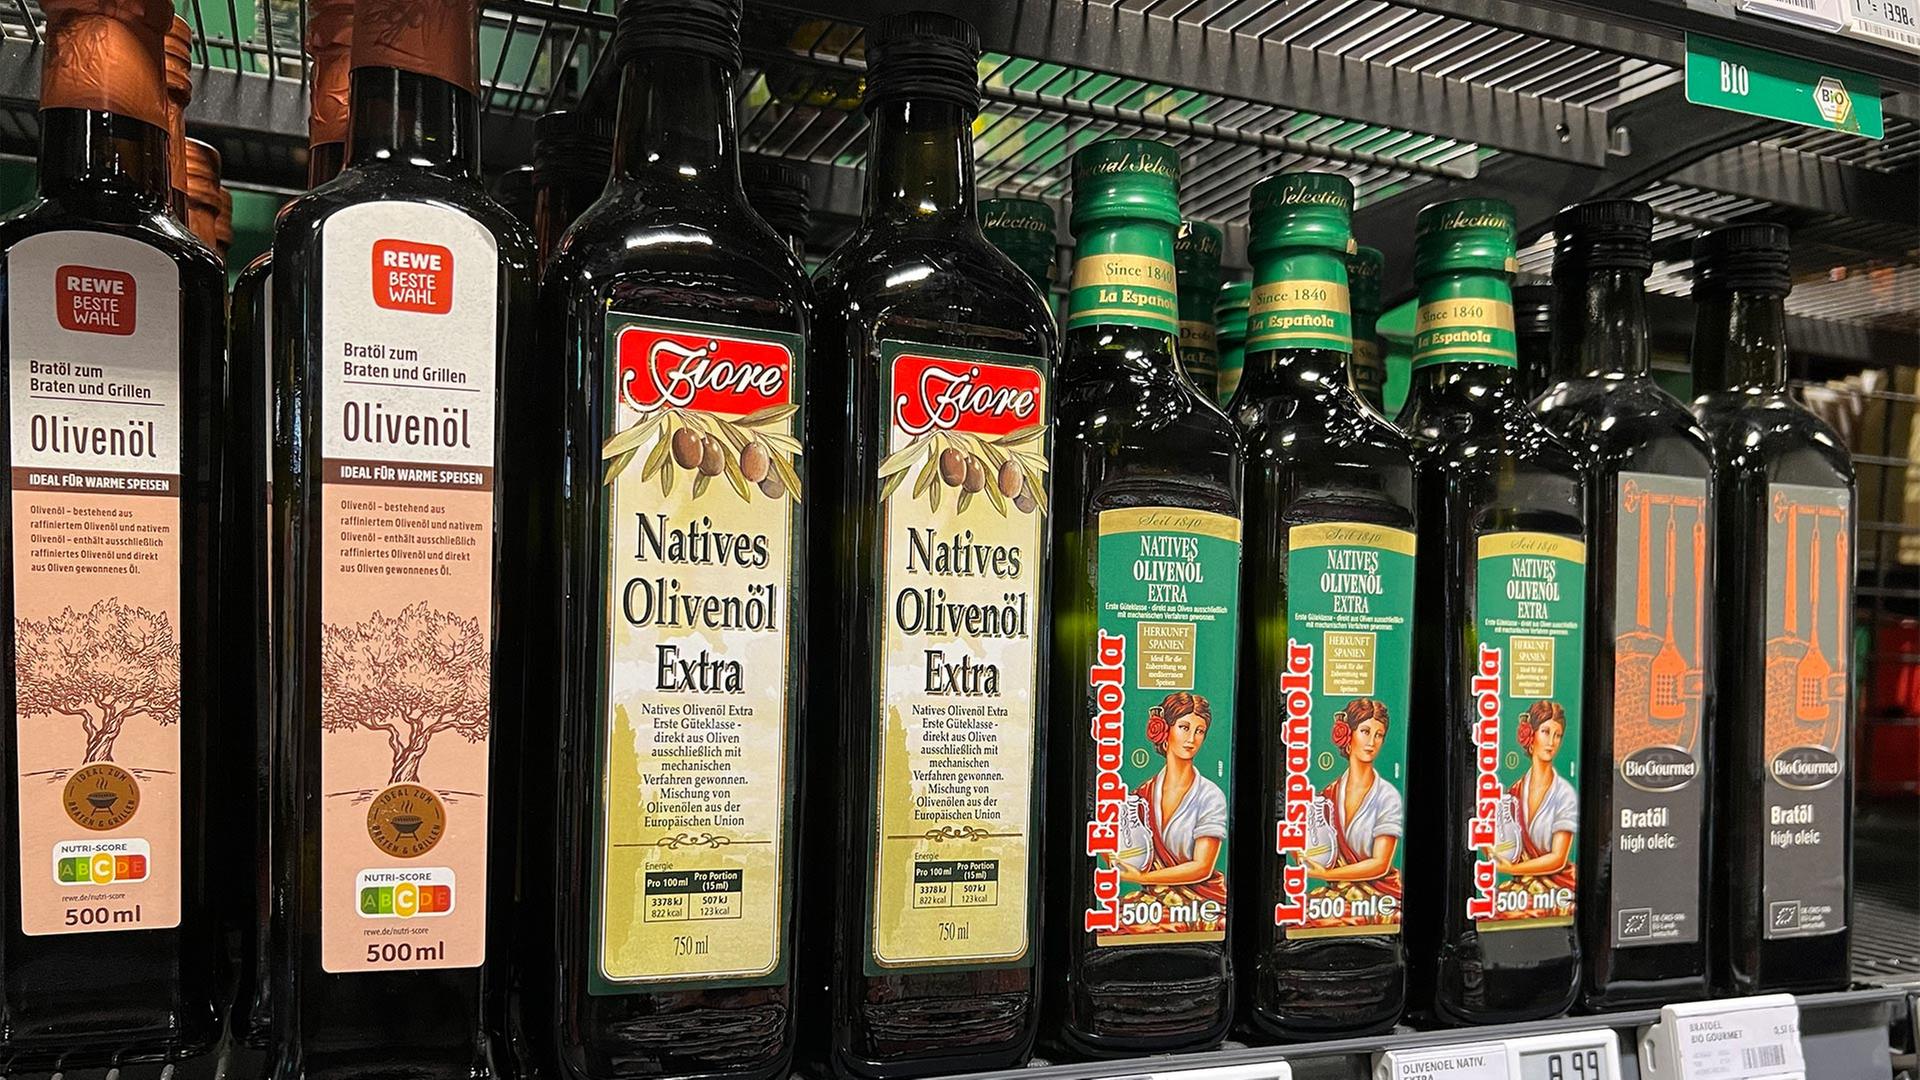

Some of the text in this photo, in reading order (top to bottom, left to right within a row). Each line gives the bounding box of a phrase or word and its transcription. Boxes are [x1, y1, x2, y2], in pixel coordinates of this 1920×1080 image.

[1720, 61, 1749, 96] BIO
[1280, 185, 1348, 209] Selection
[983, 211, 1048, 232] Selection
[383, 250, 441, 271] REWE
[389, 271, 436, 289] BESTE
[1105, 261, 1172, 283] Since 1840
[67, 275, 125, 296] REWE
[73, 296, 120, 313] BESTE
[389, 287, 436, 305] WAHL
[1099, 290, 1117, 303] La
[1256, 289, 1327, 305] Since 1840
[73, 310, 120, 327] WAHL
[1268, 314, 1335, 330] Española
[1422, 306, 1483, 323] Since 1840
[1432, 330, 1491, 345] Española
[344, 342, 418, 361] Bratöl zum
[30, 360, 103, 378] Bratöl zum
[344, 362, 466, 384] Braten und Grillen
[622, 339, 785, 412] Fiore
[30, 378, 151, 399] Braten und Grillen
[895, 366, 1035, 436] Fiore
[343, 401, 471, 449] Olivenöl
[31, 414, 157, 458] Olivenöl
[29, 473, 170, 491] IDEAL FÜR WARME SPEISEN
[340, 465, 483, 485] IDEAL FÜR WARME SPEISEN
[340, 517, 483, 531] raffiniertem Olivenöl und nativem
[1173, 515, 1202, 530] 1840
[635, 512, 769, 568] Natives
[1140, 535, 1199, 558] NATIVES
[906, 526, 1023, 577] Natives
[1327, 549, 1379, 571] NATIVES
[47, 563, 74, 573] Oliven
[76, 565, 128, 576] gewonnenes
[129, 563, 141, 574] Öl.
[340, 564, 452, 576] aus Oliven gewonnenes Öl.
[1133, 556, 1204, 583] OLIVENÖL
[1511, 558, 1556, 579] NATIVES
[1320, 569, 1384, 595] OLIVENÖL
[1506, 577, 1560, 601] OLIVENÖL
[1148, 584, 1188, 603] EXTRA
[622, 576, 778, 631] Olivenöl
[895, 586, 1029, 639] Olivenöl
[1333, 595, 1369, 613] EXTRA
[1517, 602, 1548, 619] EXTRA
[1143, 626, 1190, 638] HERKUNFT
[1328, 635, 1371, 646] HERKUNFT
[1148, 639, 1185, 650] SPANIEN
[1334, 648, 1366, 658] SPANIEN
[656, 644, 745, 694] Extra
[923, 649, 1001, 697] Extra
[641, 703, 753, 716] Natives Olivenöl Extra
[912, 704, 1008, 717] Natives Olivenöl Extra
[654, 732, 740, 744] direkt aus Oliven
[651, 745, 741, 757] ausschließlich mit
[661, 760, 731, 771] mechanischen
[929, 757, 990, 768] mechanischen
[1625, 760, 1695, 777] BioGourmet
[1774, 759, 1838, 776] BioGourmet
[643, 773, 748, 788] Verfahren gewonnen.
[913, 770, 1004, 784] Verfahren gewonnen.
[1085, 634, 1128, 932] La Española
[1275, 643, 1316, 926] La Española
[1467, 647, 1503, 920] La Española
[660, 787, 731, 801] Mischung von
[928, 783, 989, 797] Mischung von
[646, 801, 741, 814] Olivenölen aus der
[914, 809, 1001, 822] Europäischen Union
[1770, 804, 1813, 825] Bratöl
[644, 815, 744, 830] Europäischen Union
[1621, 807, 1668, 828] Bratöl
[1620, 832, 1676, 852] high oleic
[1770, 828, 1820, 848] high oleic
[61, 843, 127, 853] NUTRI-SCORE
[645, 862, 674, 871] Energie
[364, 872, 432, 882] NUTRI-SCORE
[1308, 898, 1345, 919] 500
[1496, 891, 1527, 912] 500
[65, 905, 141, 926] 500 ml
[1122, 902, 1163, 925] 500
[363, 926, 429, 936] rewe.de/nutri-score
[938, 921, 969, 941] 750 ml
[366, 941, 444, 962] 500 ml
[673, 935, 709, 956] 750 ml
[1706, 1030, 1743, 1042] GOURMET
[1403, 1056, 1486, 1074] OLIVENOEL NATIV.
